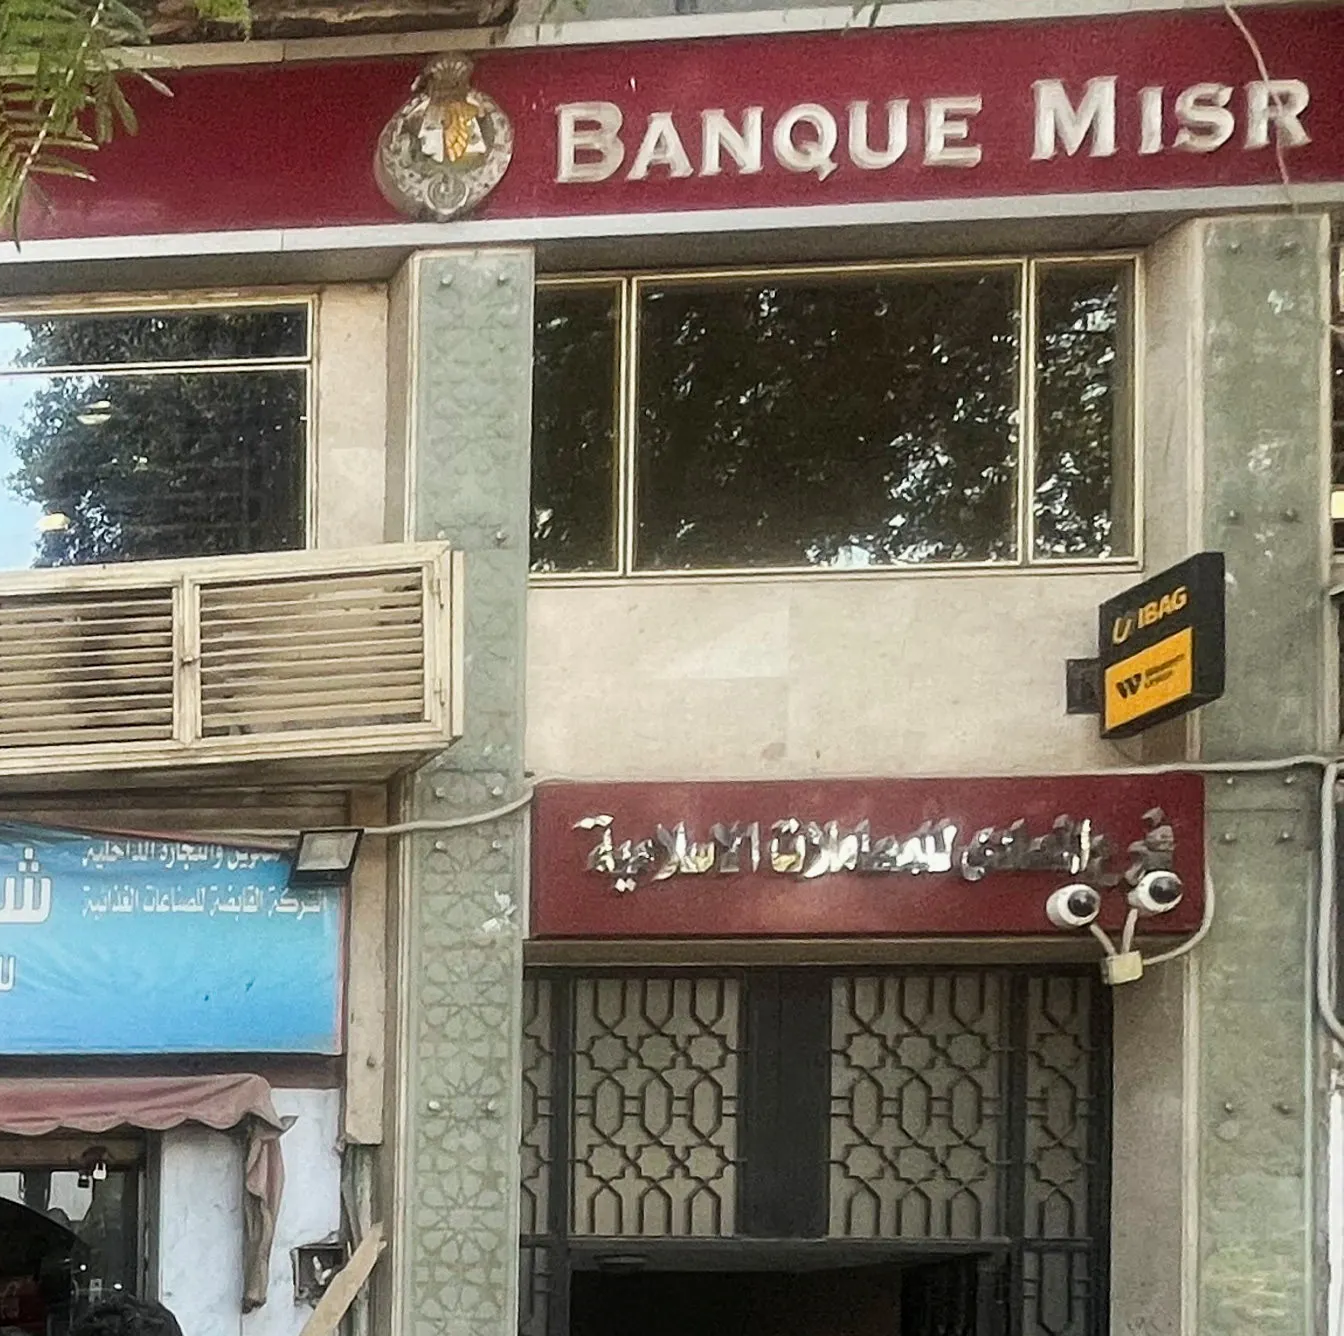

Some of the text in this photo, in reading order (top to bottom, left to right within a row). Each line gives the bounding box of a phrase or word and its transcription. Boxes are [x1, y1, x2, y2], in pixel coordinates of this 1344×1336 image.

[554, 75, 1313, 184] BANQUE MISR
[1137, 585, 1189, 629] IBAG
